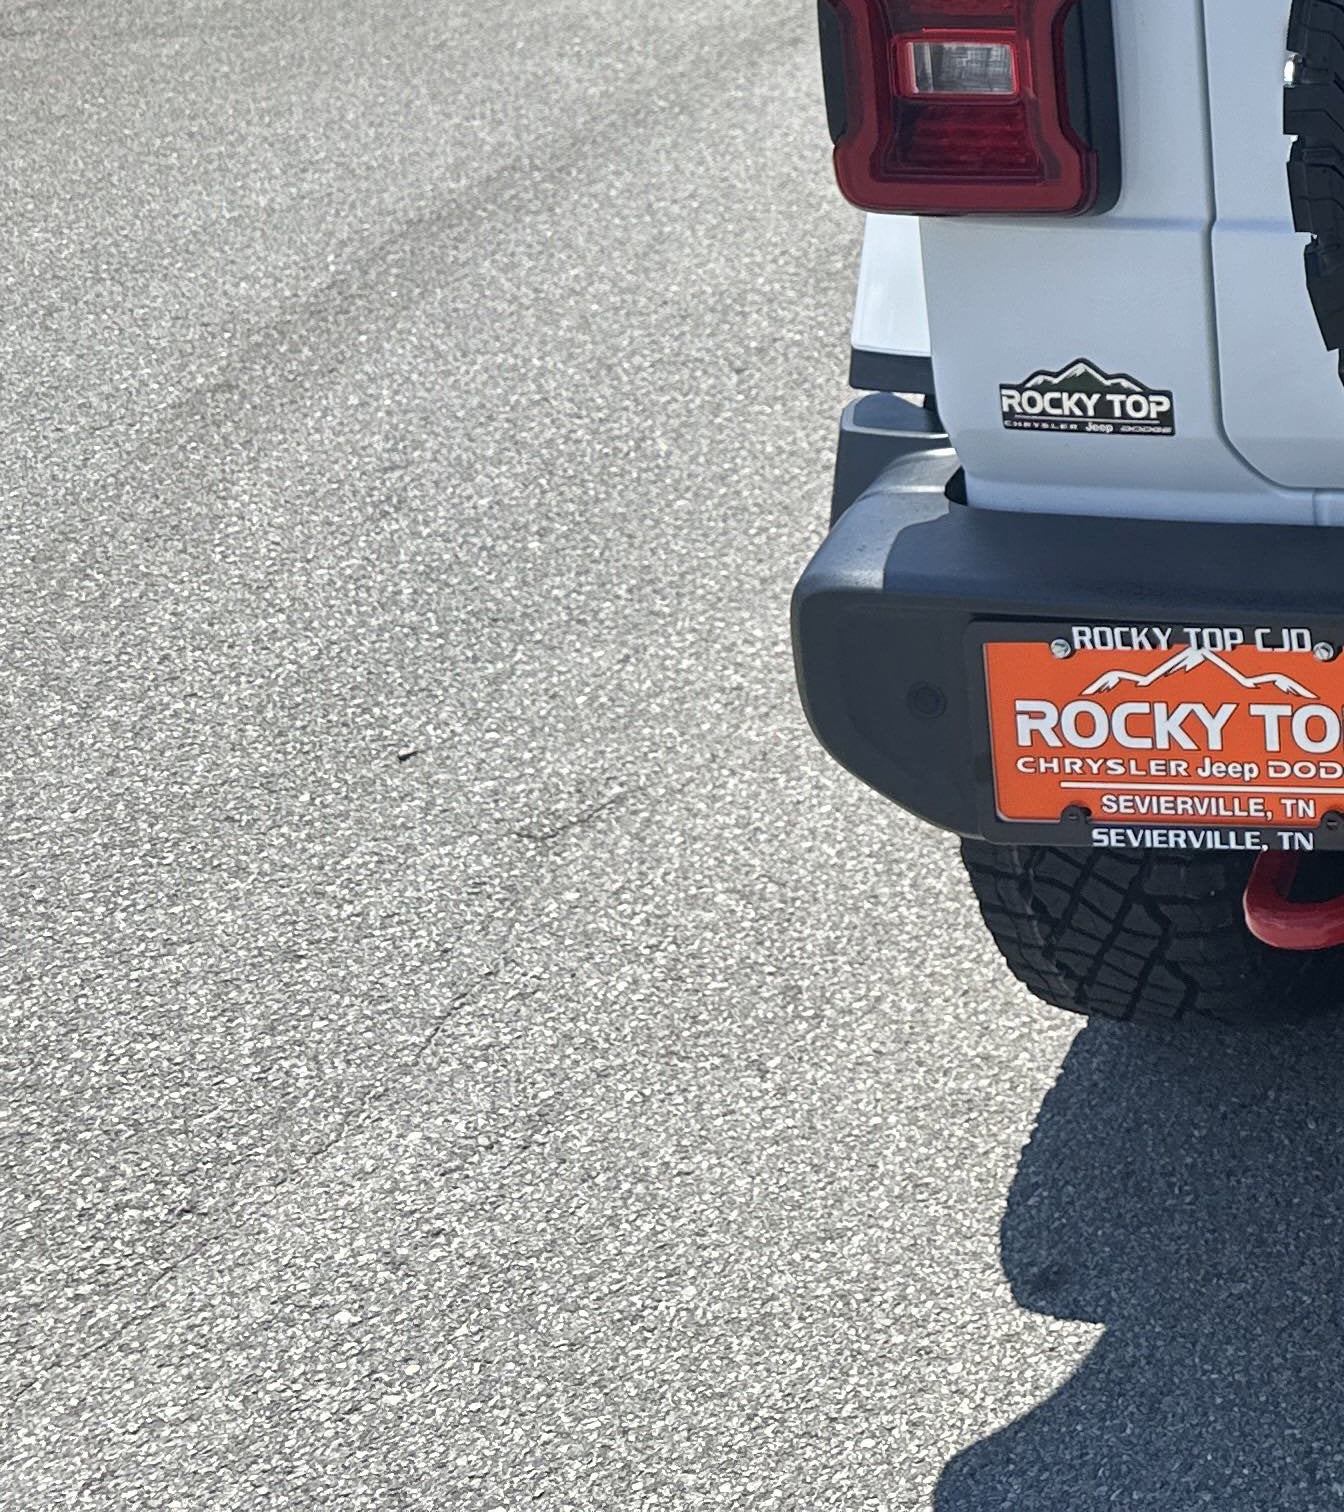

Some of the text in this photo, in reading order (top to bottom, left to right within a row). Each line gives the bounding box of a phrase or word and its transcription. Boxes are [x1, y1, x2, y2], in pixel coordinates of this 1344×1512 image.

[1001, 389, 1171, 419] ROCKY TOP
[1004, 420, 1078, 430] CHRYSLER
[1085, 421, 1114, 434] Jeep
[1071, 626, 1312, 653] ROCKY TOP CJD
[1015, 699, 1238, 751] ROCKY
[1016, 757, 1190, 777] CHRYSLER
[1197, 757, 1259, 781] Jeep
[1101, 794, 1316, 821] SEVIERVILLE, TN
[1092, 827, 1314, 852] SEVIERVILLE, TN
